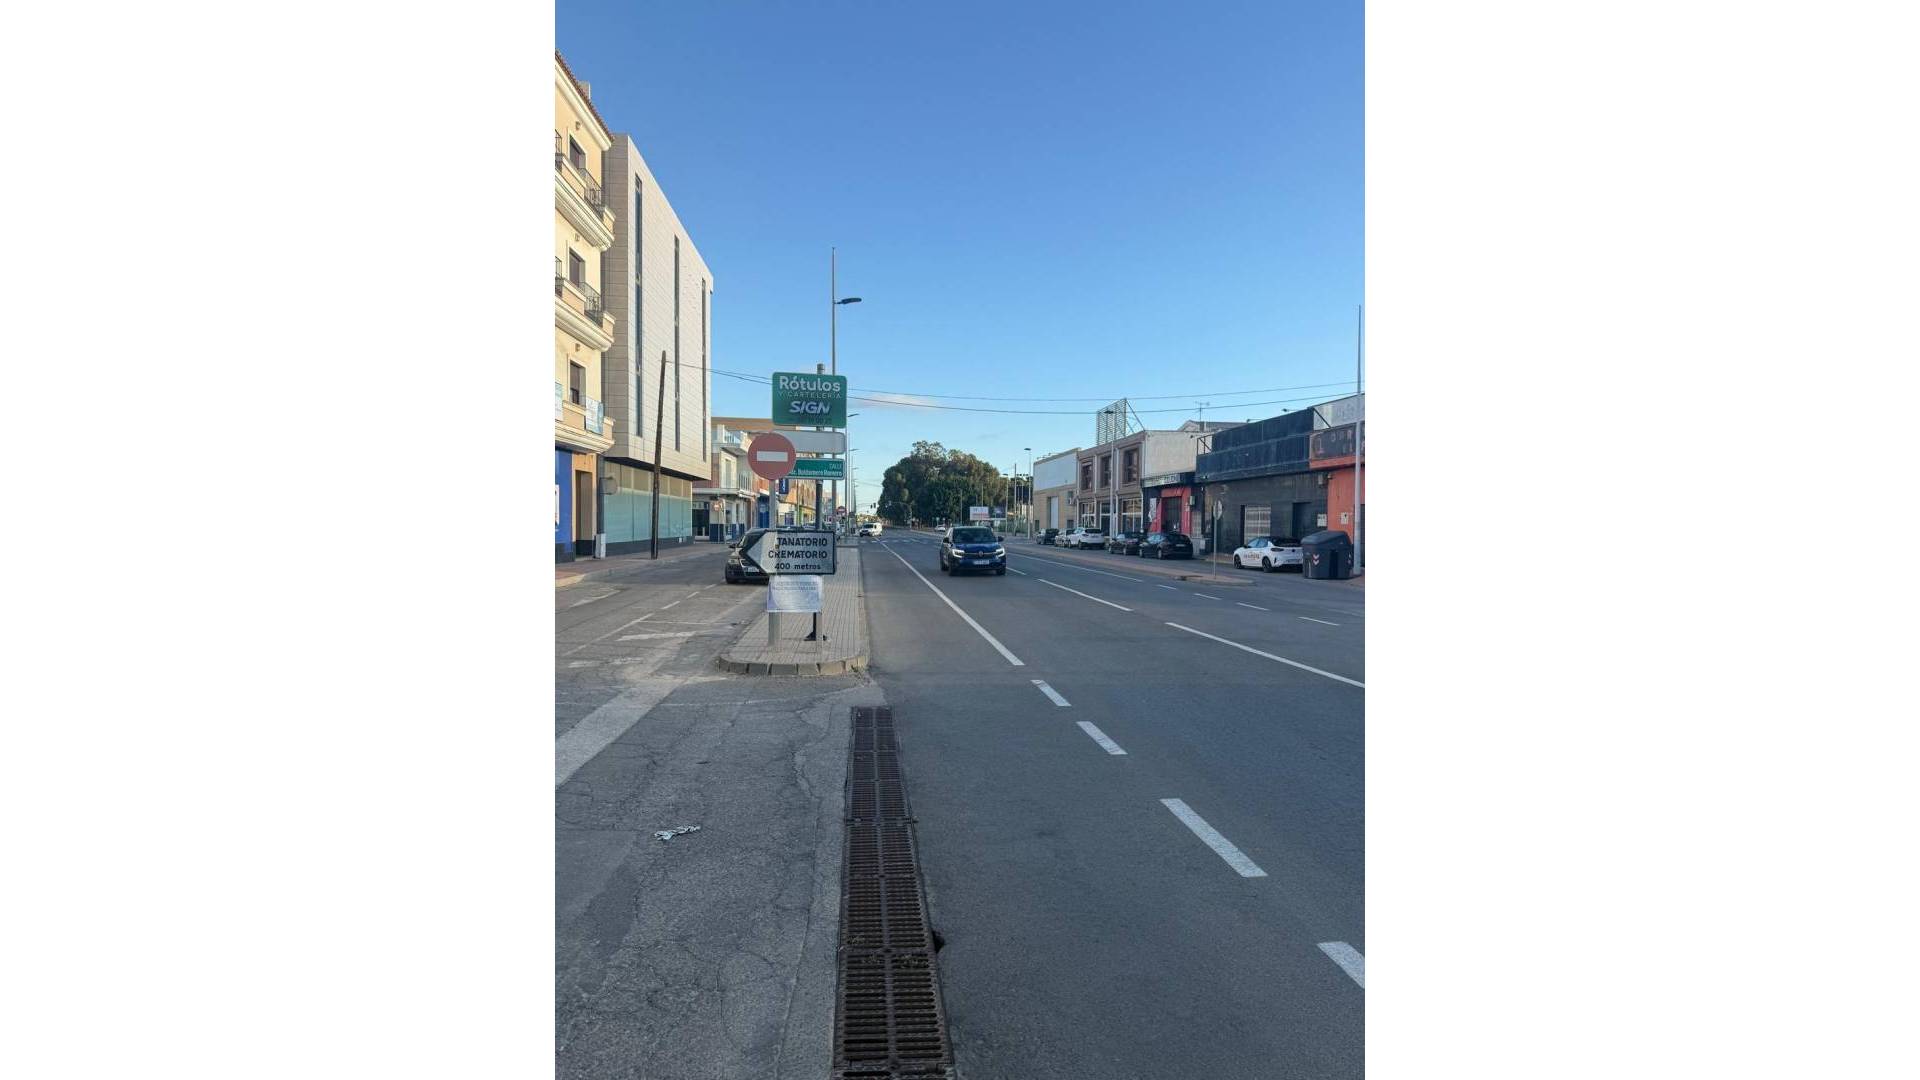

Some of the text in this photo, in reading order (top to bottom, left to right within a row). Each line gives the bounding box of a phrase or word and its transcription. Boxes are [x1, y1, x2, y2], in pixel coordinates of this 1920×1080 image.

[779, 375, 841, 392] Rótulos
[789, 400, 831, 414] SIGN
[776, 537, 828, 546] TANATORIO
[768, 550, 828, 559] CREMATORIO
[774, 562, 790, 570] 400
